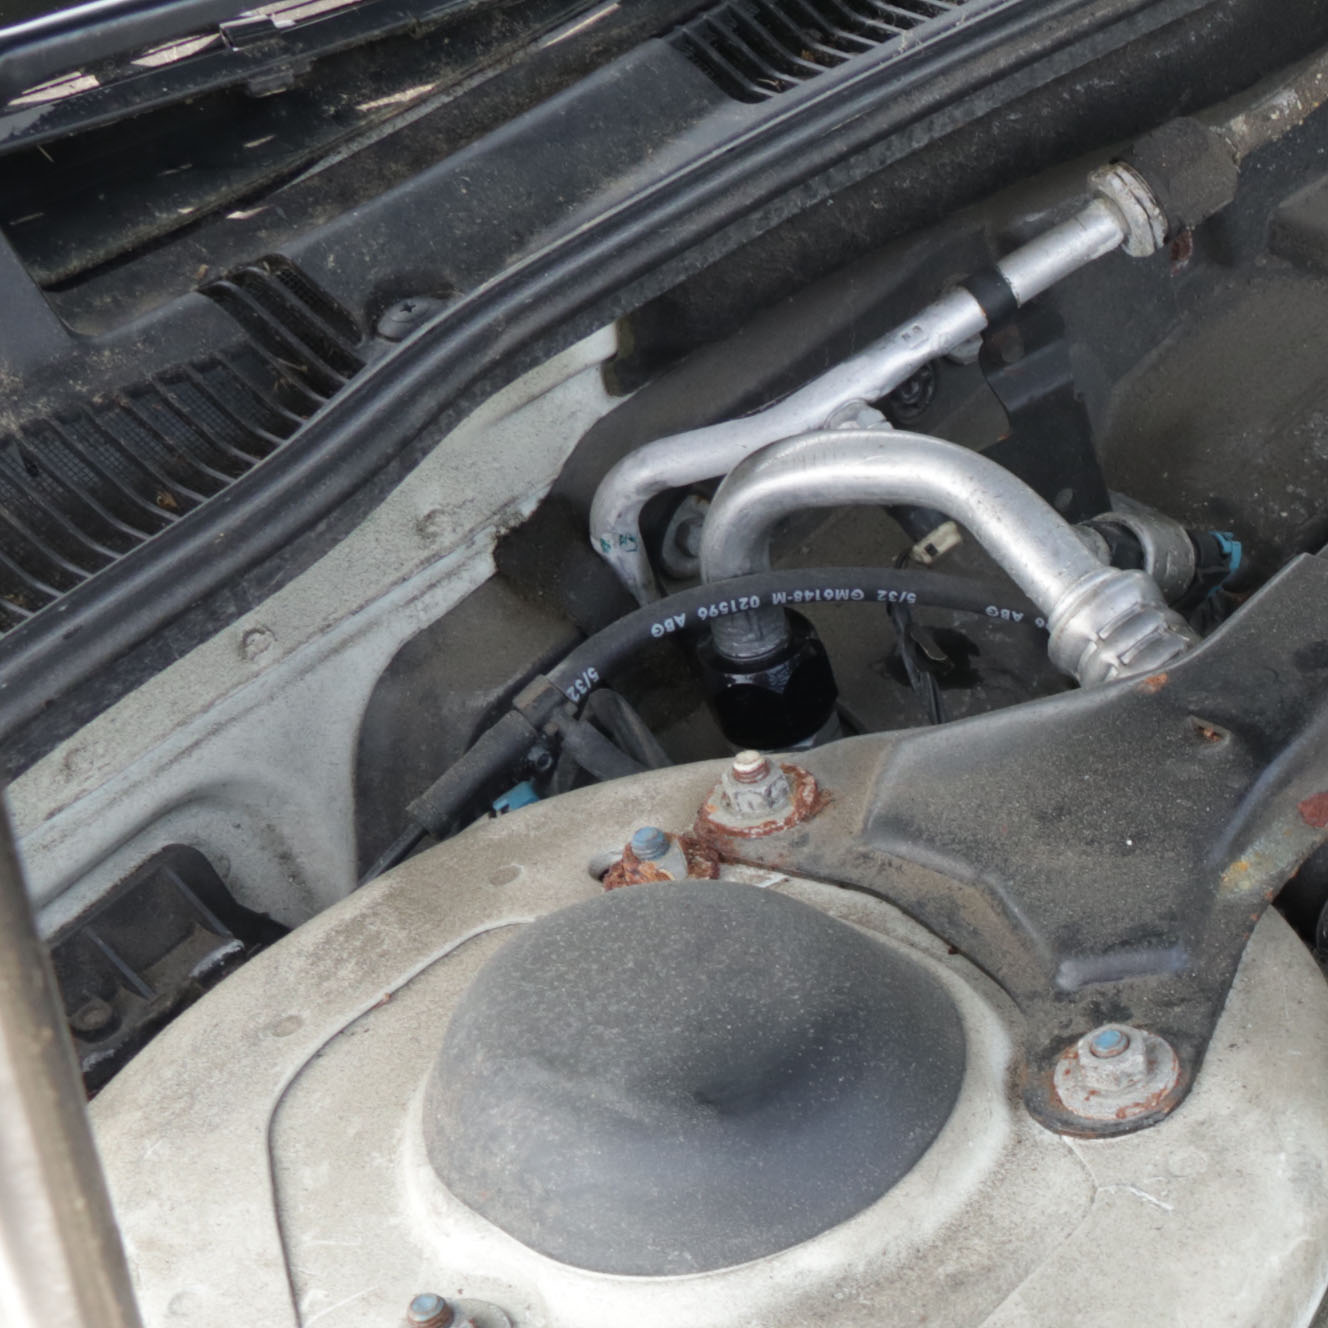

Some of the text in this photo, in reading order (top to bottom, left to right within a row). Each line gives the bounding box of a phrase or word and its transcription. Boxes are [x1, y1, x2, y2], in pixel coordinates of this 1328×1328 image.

[696, 593, 760, 619] 021596
[771, 587, 864, 604] GM6148-M
[876, 587, 916, 604] 5/32
[649, 610, 686, 638] ABG
[565, 665, 600, 703] 5/32
